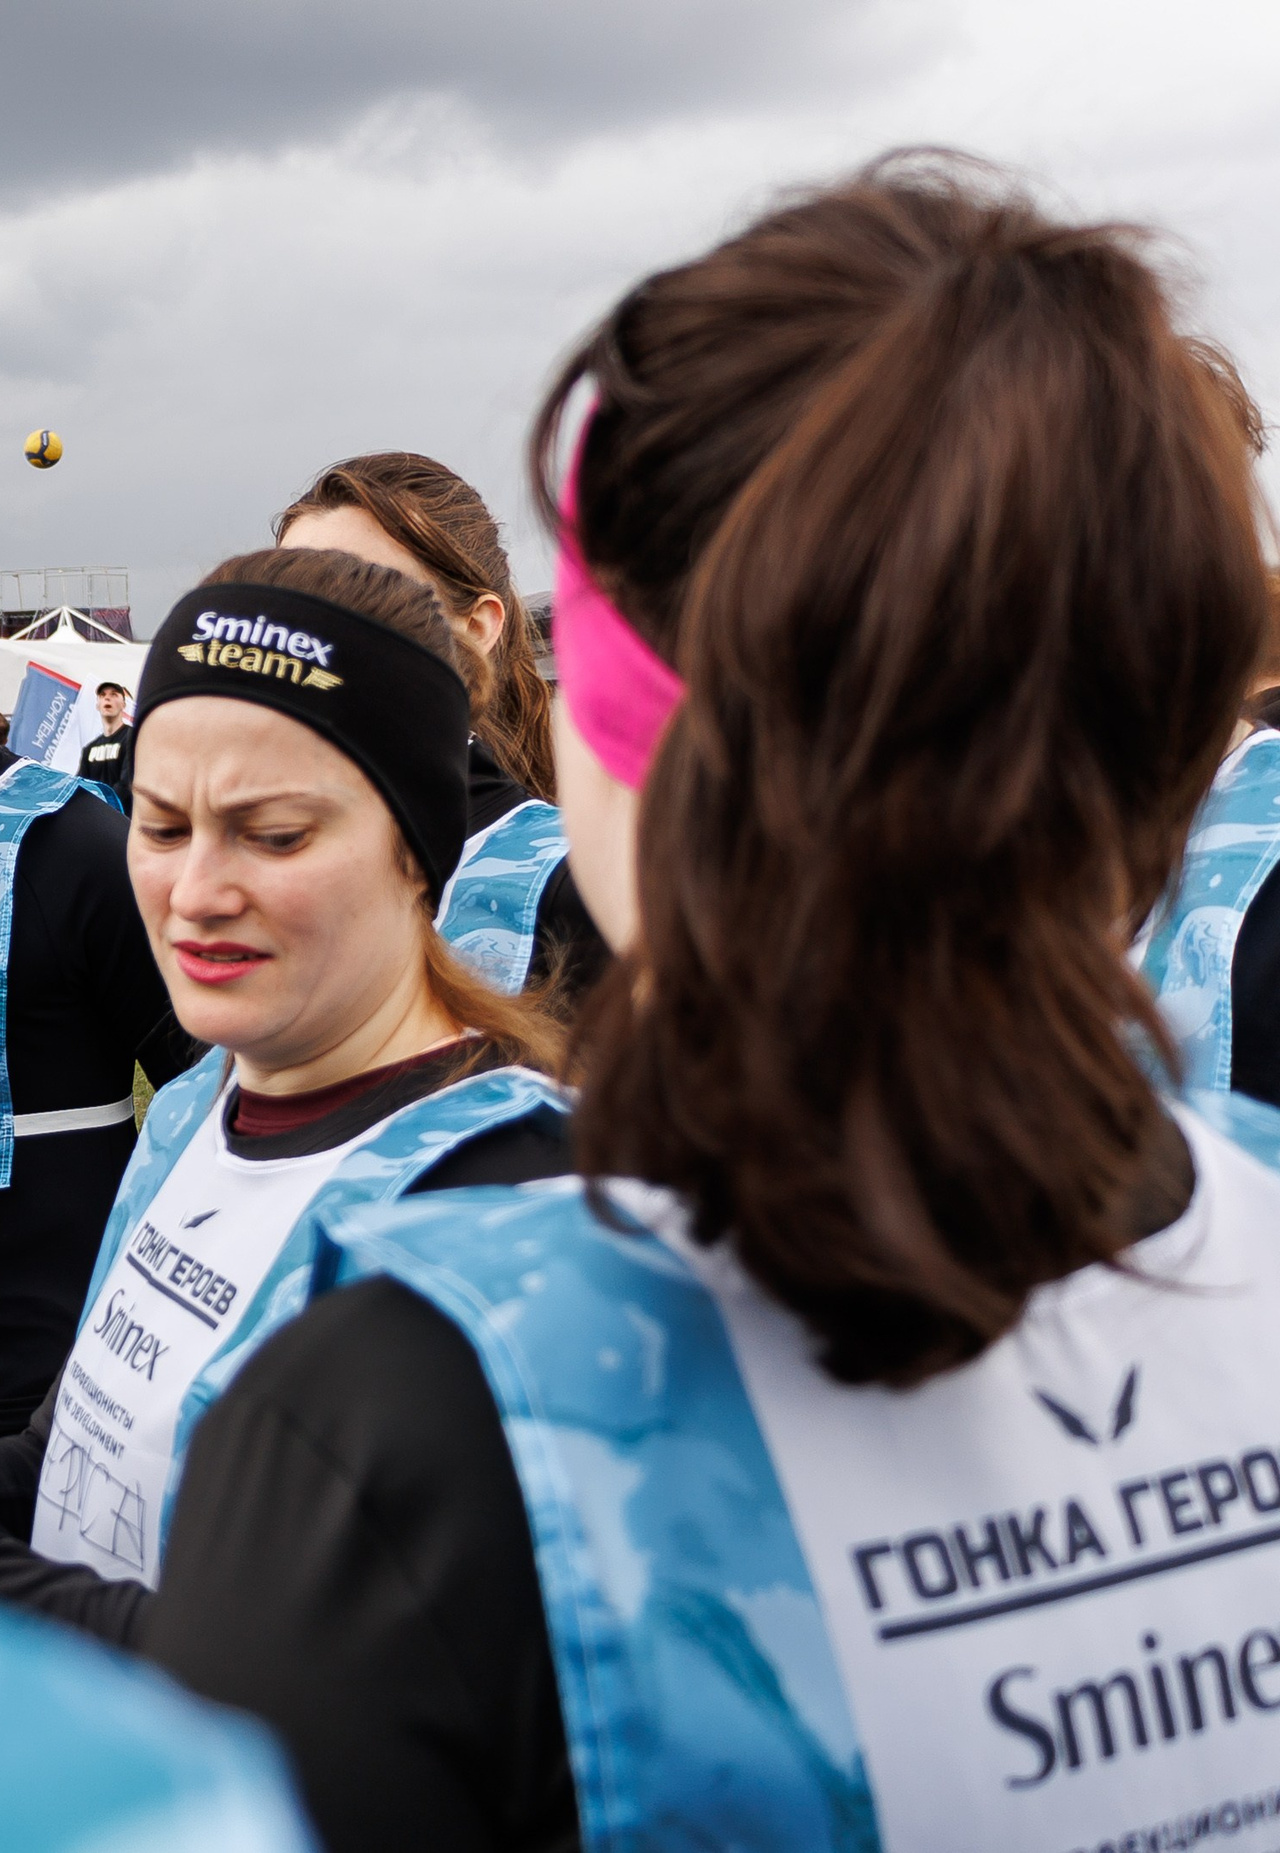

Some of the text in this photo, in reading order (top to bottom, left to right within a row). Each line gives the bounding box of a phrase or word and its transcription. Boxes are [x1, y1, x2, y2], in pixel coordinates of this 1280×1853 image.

[192, 611, 334, 667] Sminex
[207, 639, 303, 684] team
[157, 1245, 238, 1316] ГЕРОЕВ
[93, 1288, 171, 1381] Sminex
[852, 1499, 1107, 1611] ГОНКА
